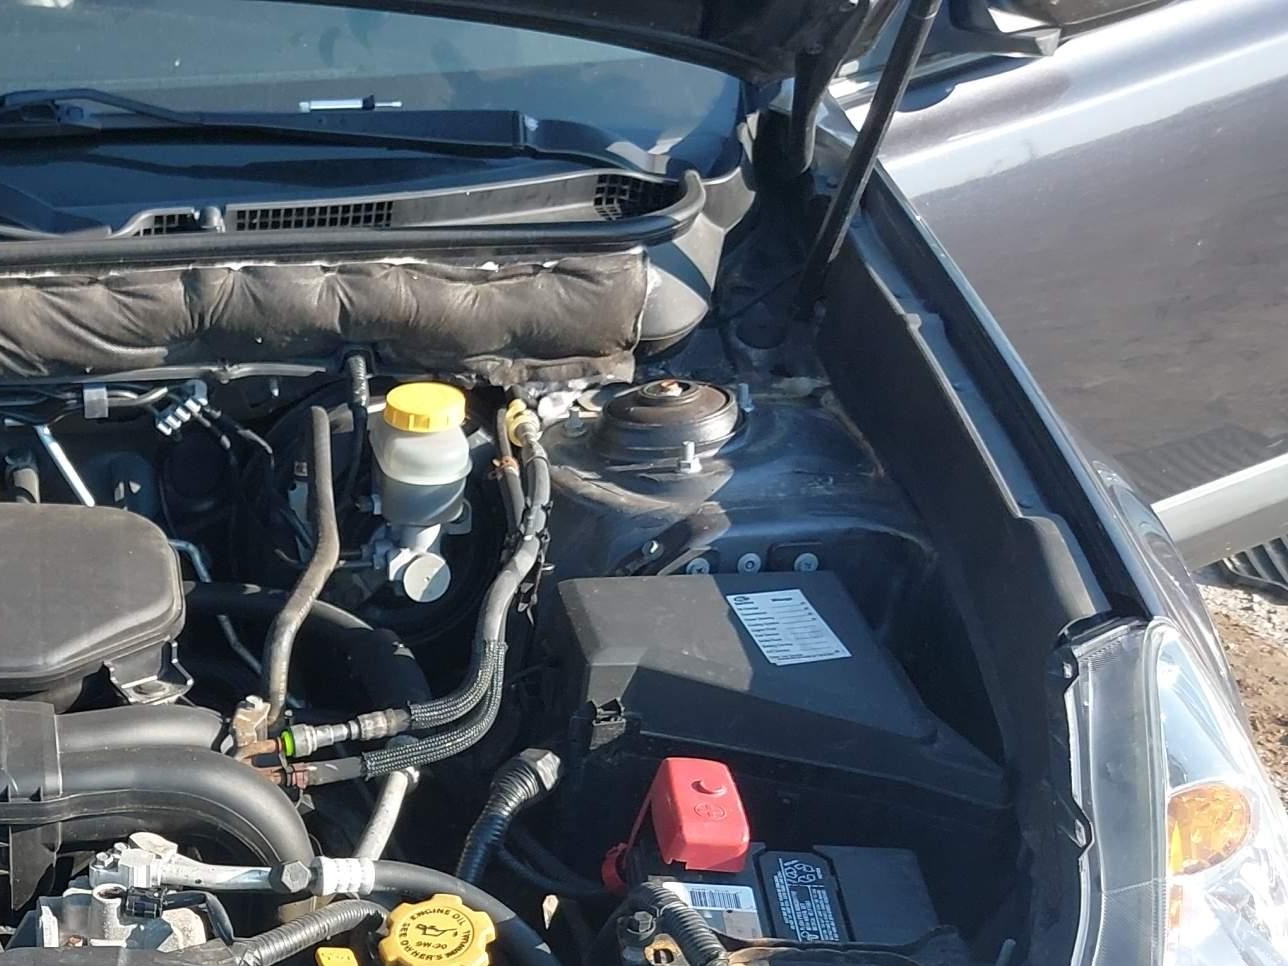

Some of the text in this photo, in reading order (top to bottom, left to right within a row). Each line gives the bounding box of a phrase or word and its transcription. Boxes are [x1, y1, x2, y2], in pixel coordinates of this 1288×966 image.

[410, 907, 467, 927] ENGINE OIL
[398, 922, 411, 938] SEE
